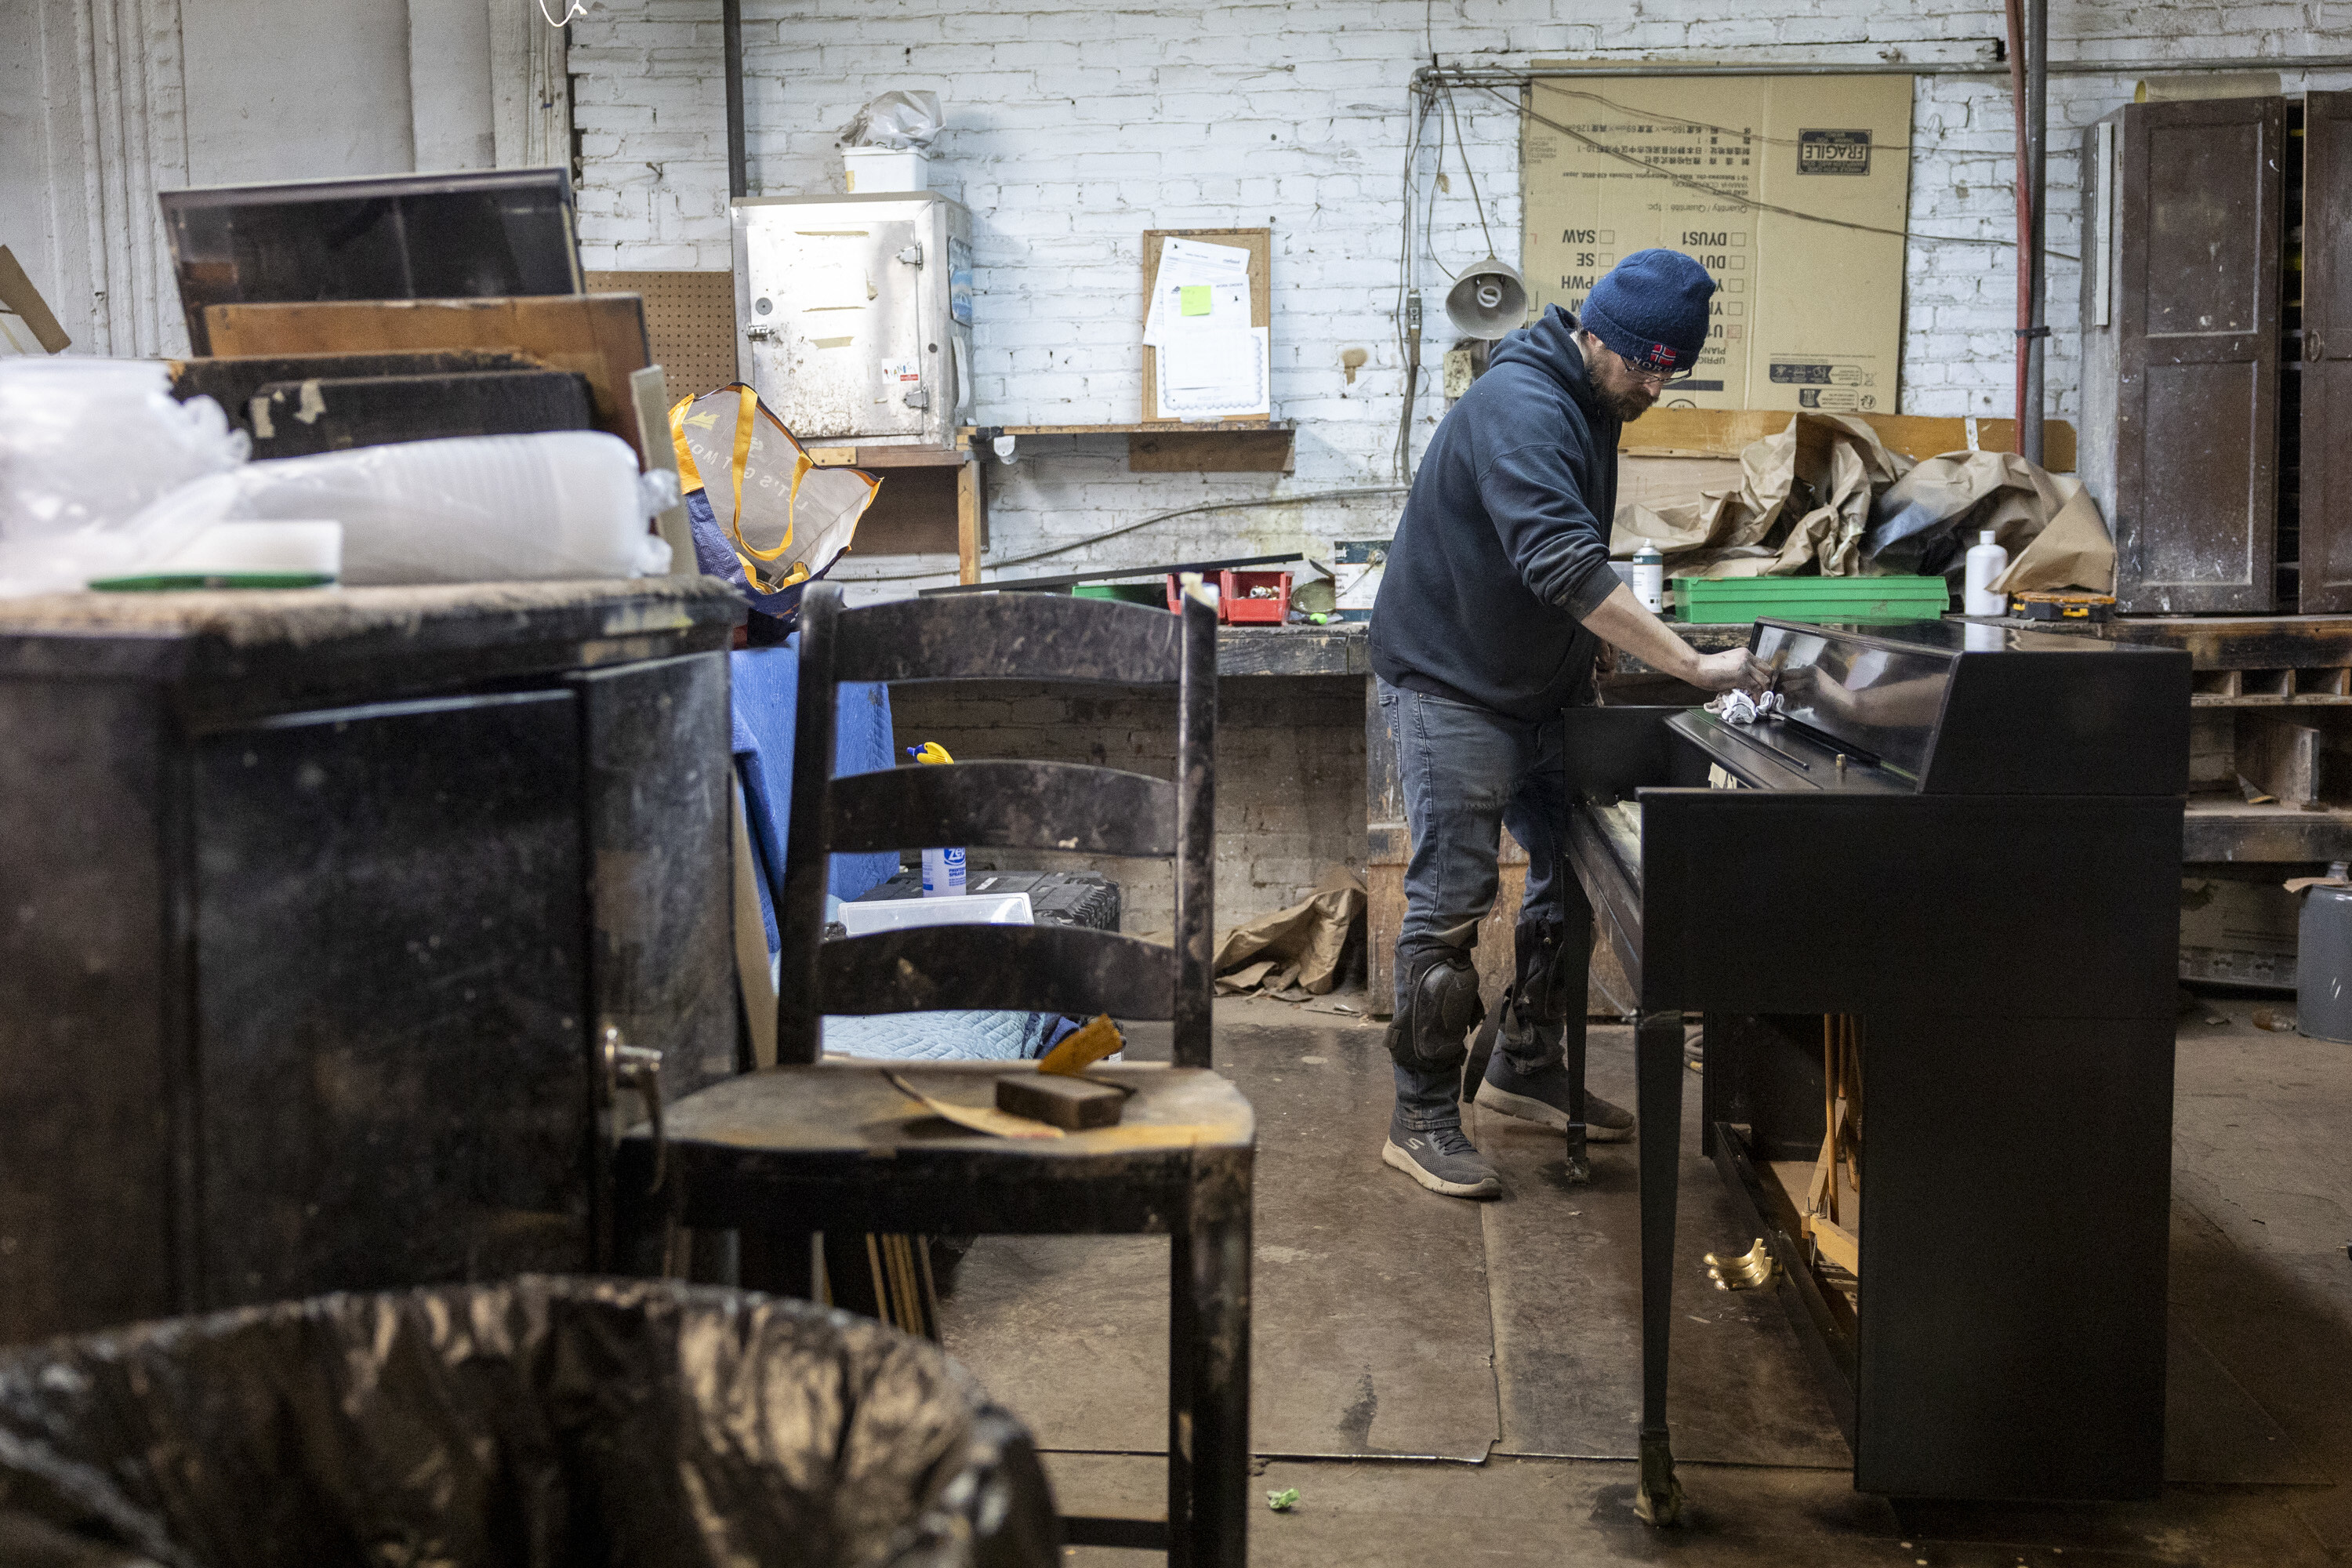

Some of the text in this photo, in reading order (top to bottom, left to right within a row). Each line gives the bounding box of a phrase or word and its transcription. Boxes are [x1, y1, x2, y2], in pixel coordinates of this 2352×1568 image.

[1805, 144, 1864, 159] FRAGILE
[1647, 203, 1662, 212] 1pc
[1711, 203, 1748, 213] Quantity
[1562, 230, 1596, 244] SAW
[1682, 231, 1727, 246] DYUS1
[1576, 252, 1595, 267] SE
[1561, 275, 1594, 289] PWH
